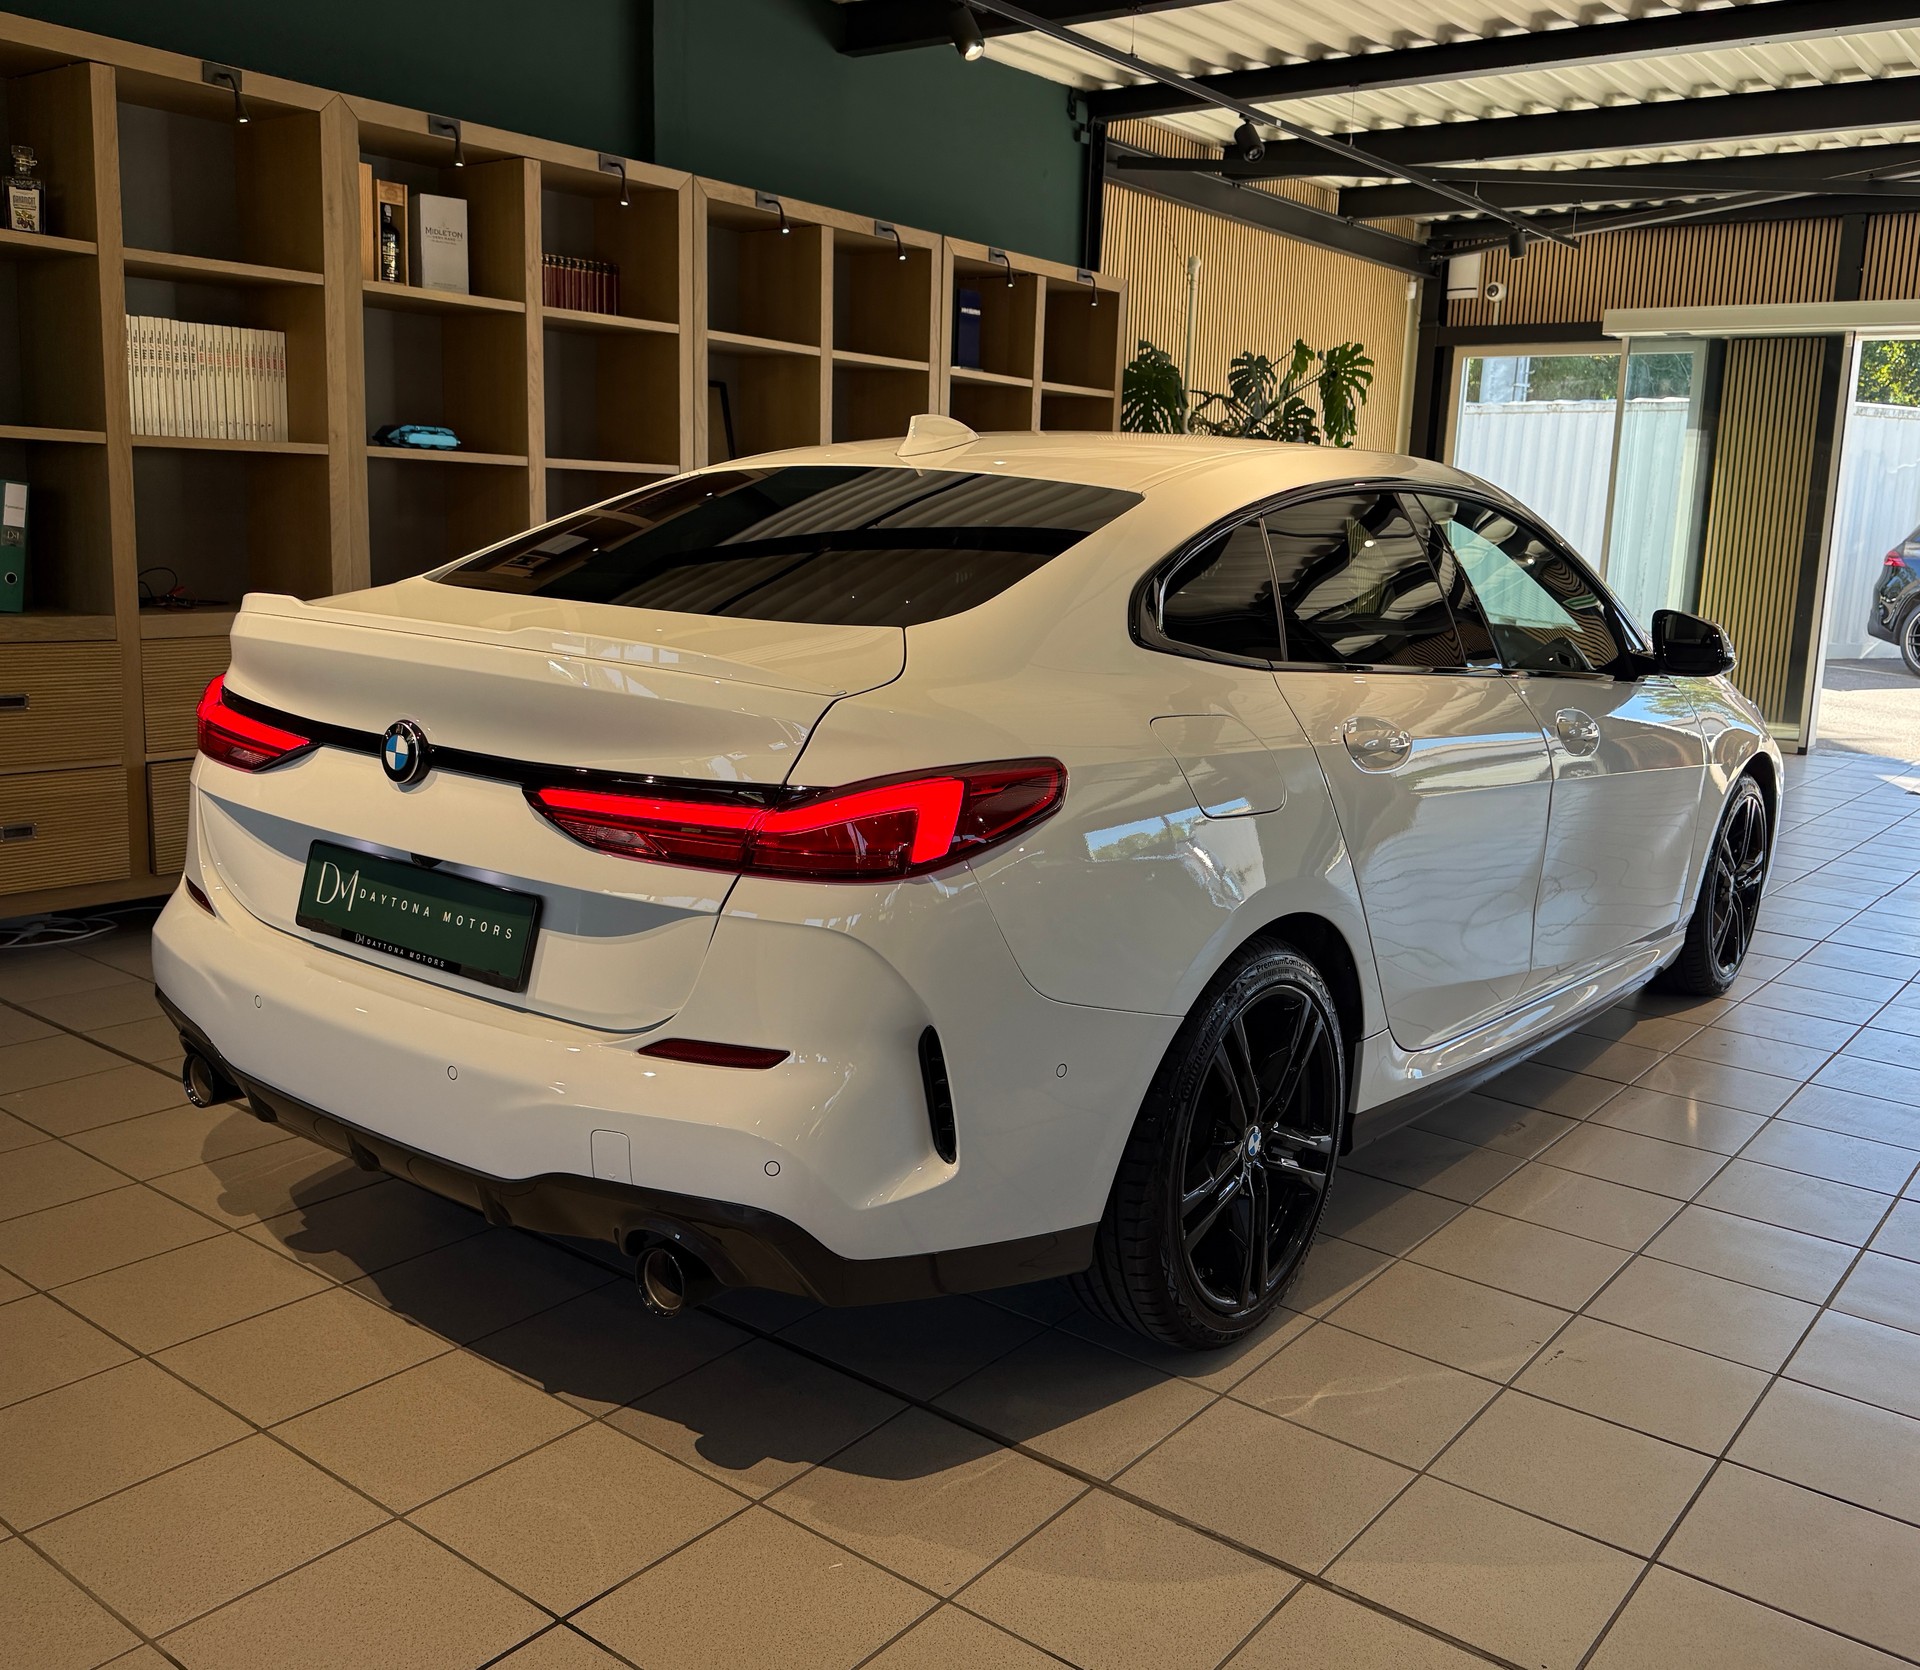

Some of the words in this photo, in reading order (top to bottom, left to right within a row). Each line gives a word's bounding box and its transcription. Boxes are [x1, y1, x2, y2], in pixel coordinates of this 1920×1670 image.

[425, 227, 463, 239] MIDLETON
[316, 861, 360, 912] DM
[360, 888, 430, 917] DAYTONA
[443, 911, 513, 940] MOTORS
[367, 938, 404, 956] DAYTONA
[409, 951, 445, 968] MOTORS
